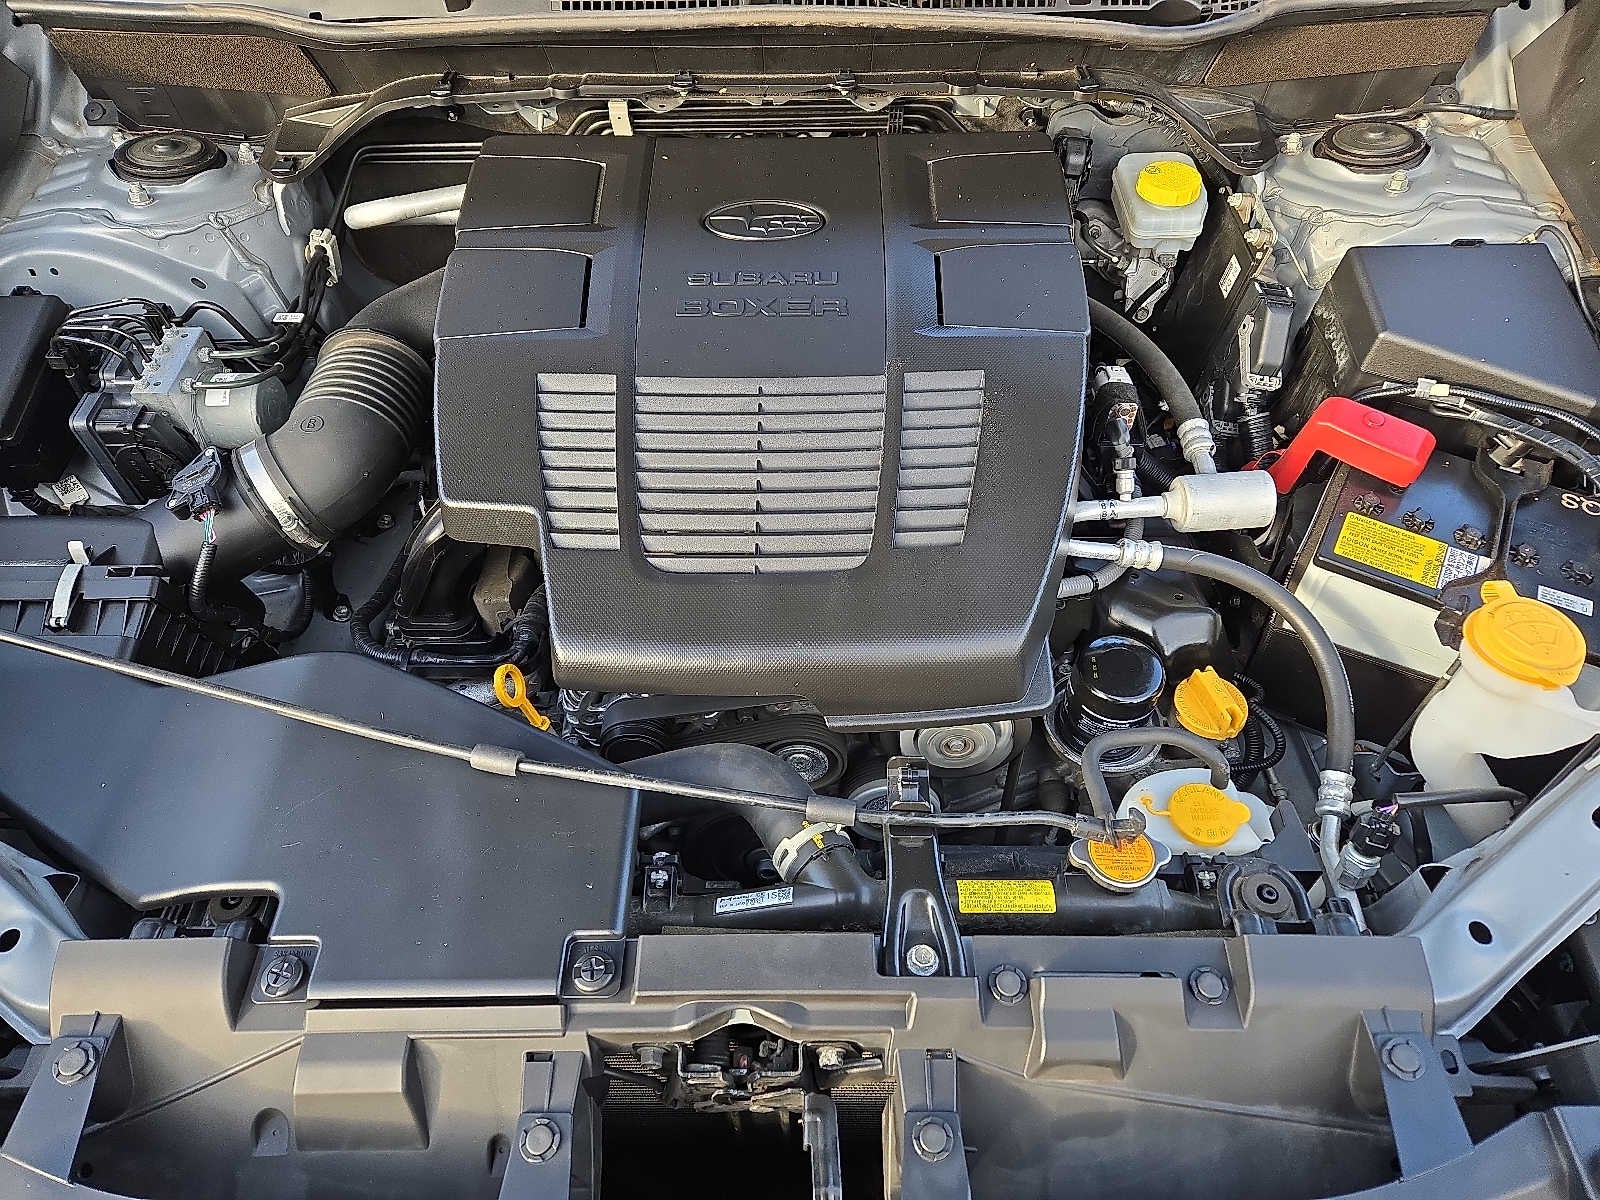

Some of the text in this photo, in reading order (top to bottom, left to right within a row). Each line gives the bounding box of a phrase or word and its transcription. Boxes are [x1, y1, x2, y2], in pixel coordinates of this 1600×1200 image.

[687, 271, 838, 286] SUBARU
[675, 298, 849, 317] BOXER
[1341, 535, 1369, 548] POISON
